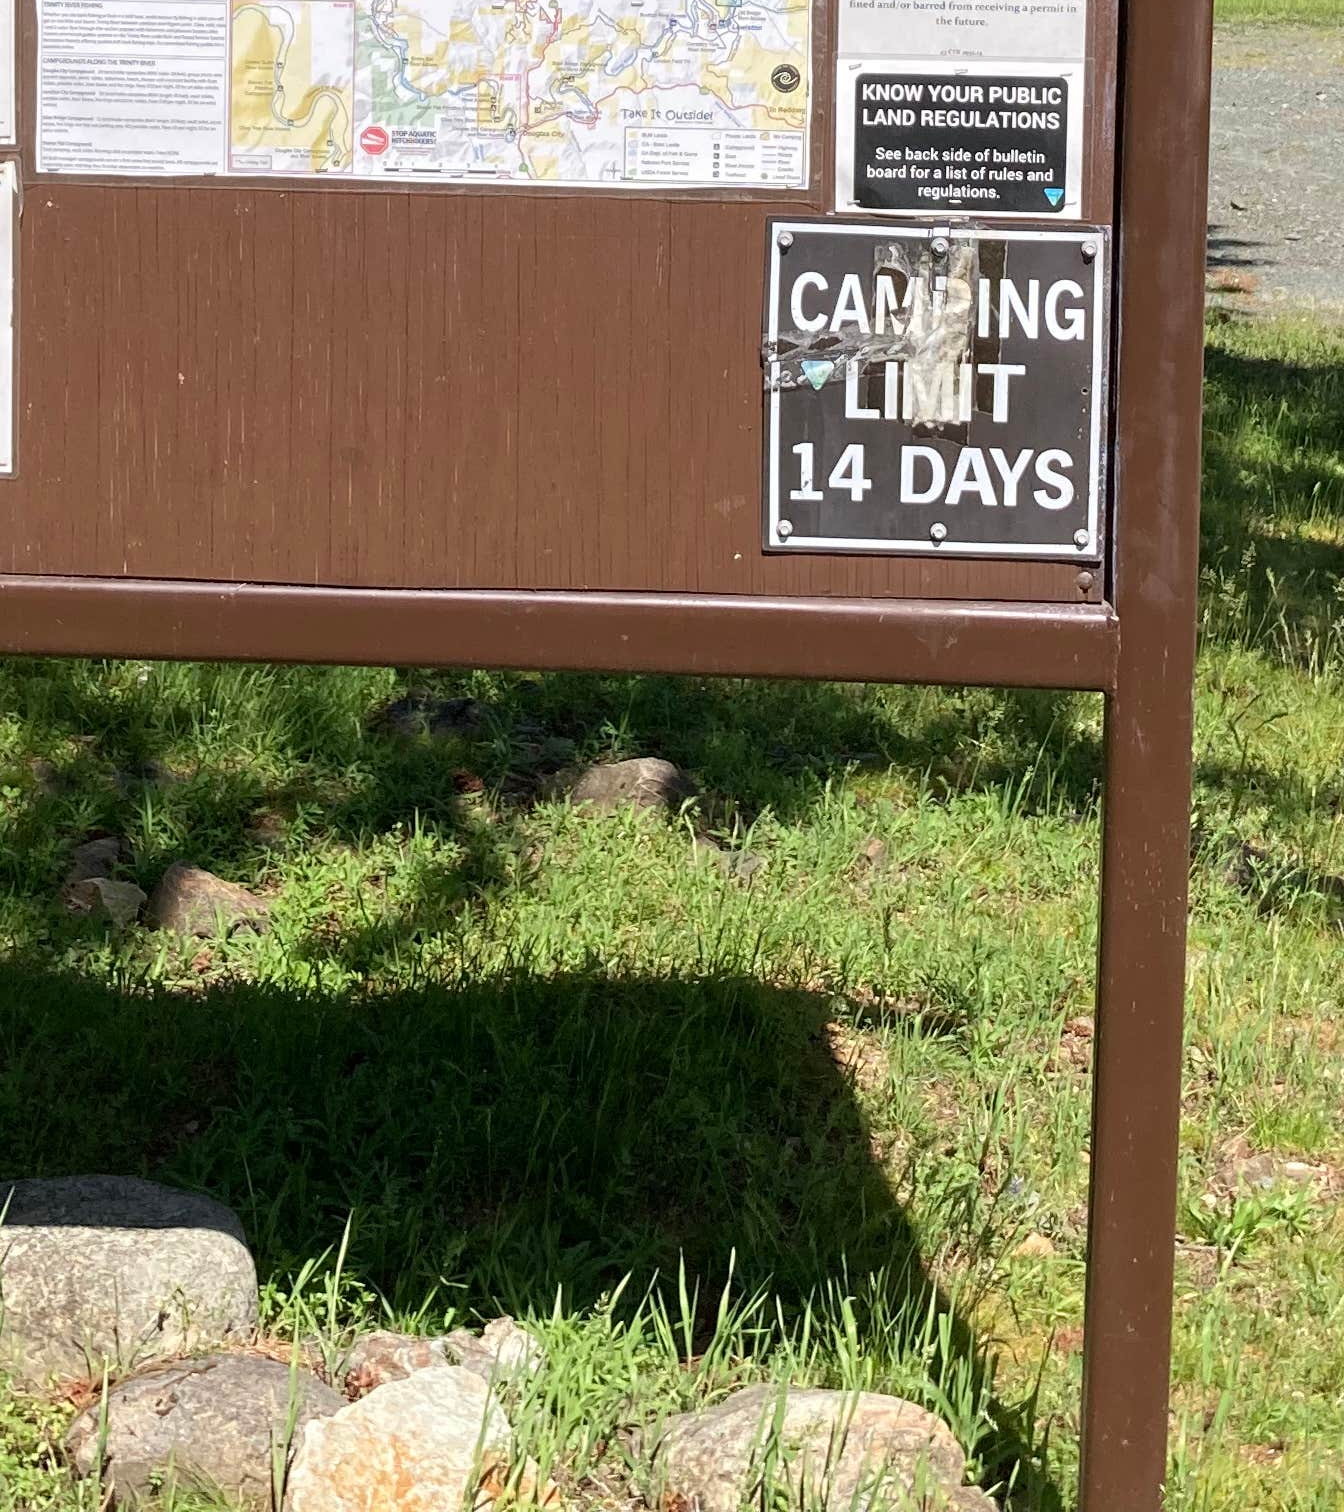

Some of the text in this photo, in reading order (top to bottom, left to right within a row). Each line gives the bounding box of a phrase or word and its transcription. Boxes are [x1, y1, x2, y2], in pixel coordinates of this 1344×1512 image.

[936, 17, 988, 27] the future.
[863, 84, 1062, 104] KNOW YOUR PUBLIC
[621, 109, 647, 120] Take
[863, 109, 1060, 129] LAND REGULATIONS
[876, 147, 1045, 164] See back side of bulletin
[867, 166, 1053, 182] board for a list of rules and
[918, 185, 1001, 200] regulations.
[790, 442, 1074, 511] 14 DAYS
